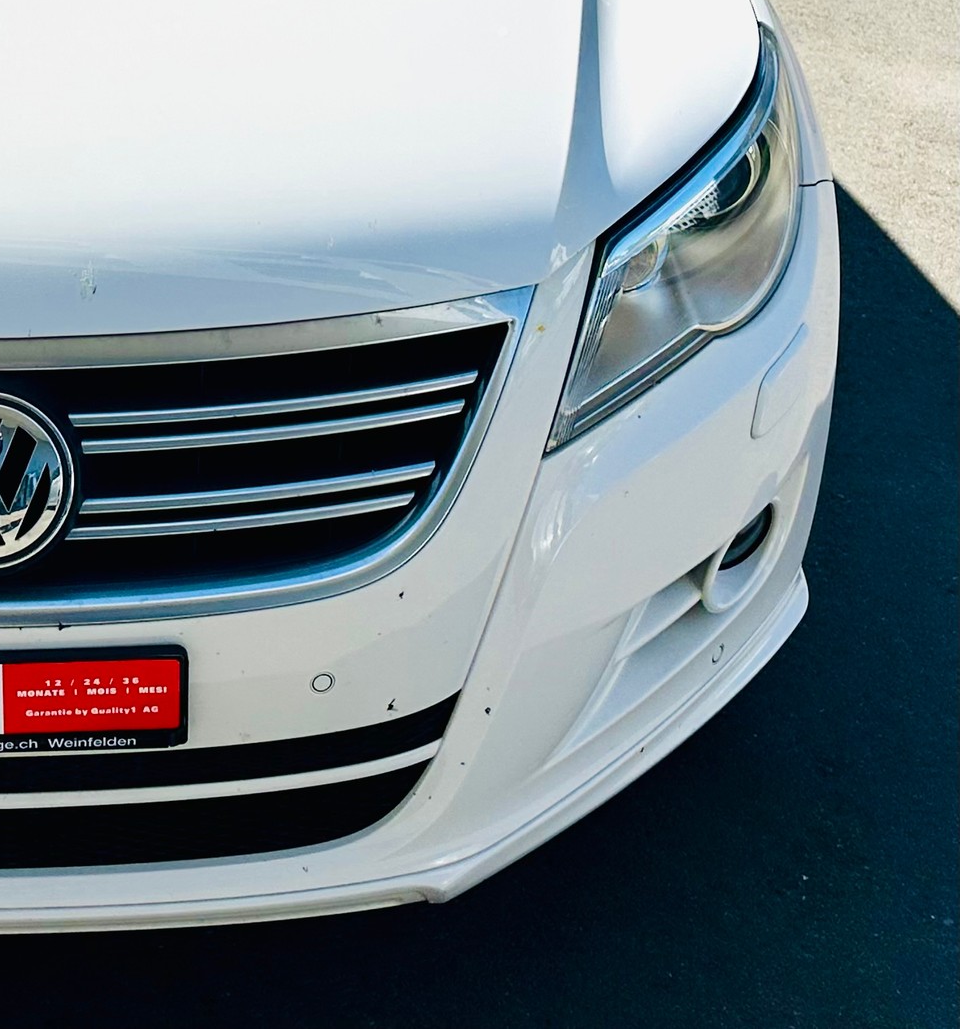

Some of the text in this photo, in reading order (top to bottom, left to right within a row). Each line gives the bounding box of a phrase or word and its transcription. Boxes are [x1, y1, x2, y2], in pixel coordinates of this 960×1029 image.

[44, 679, 62, 687] 12
[83, 678, 101, 686] 24
[122, 677, 140, 685] 36
[16, 689, 66, 698] MONATE
[86, 687, 117, 696] MOIS
[138, 686, 168, 694] MESI
[25, 705, 159, 717] Garantie by Quality1 AG
[47, 737, 137, 749] Weinfelden
